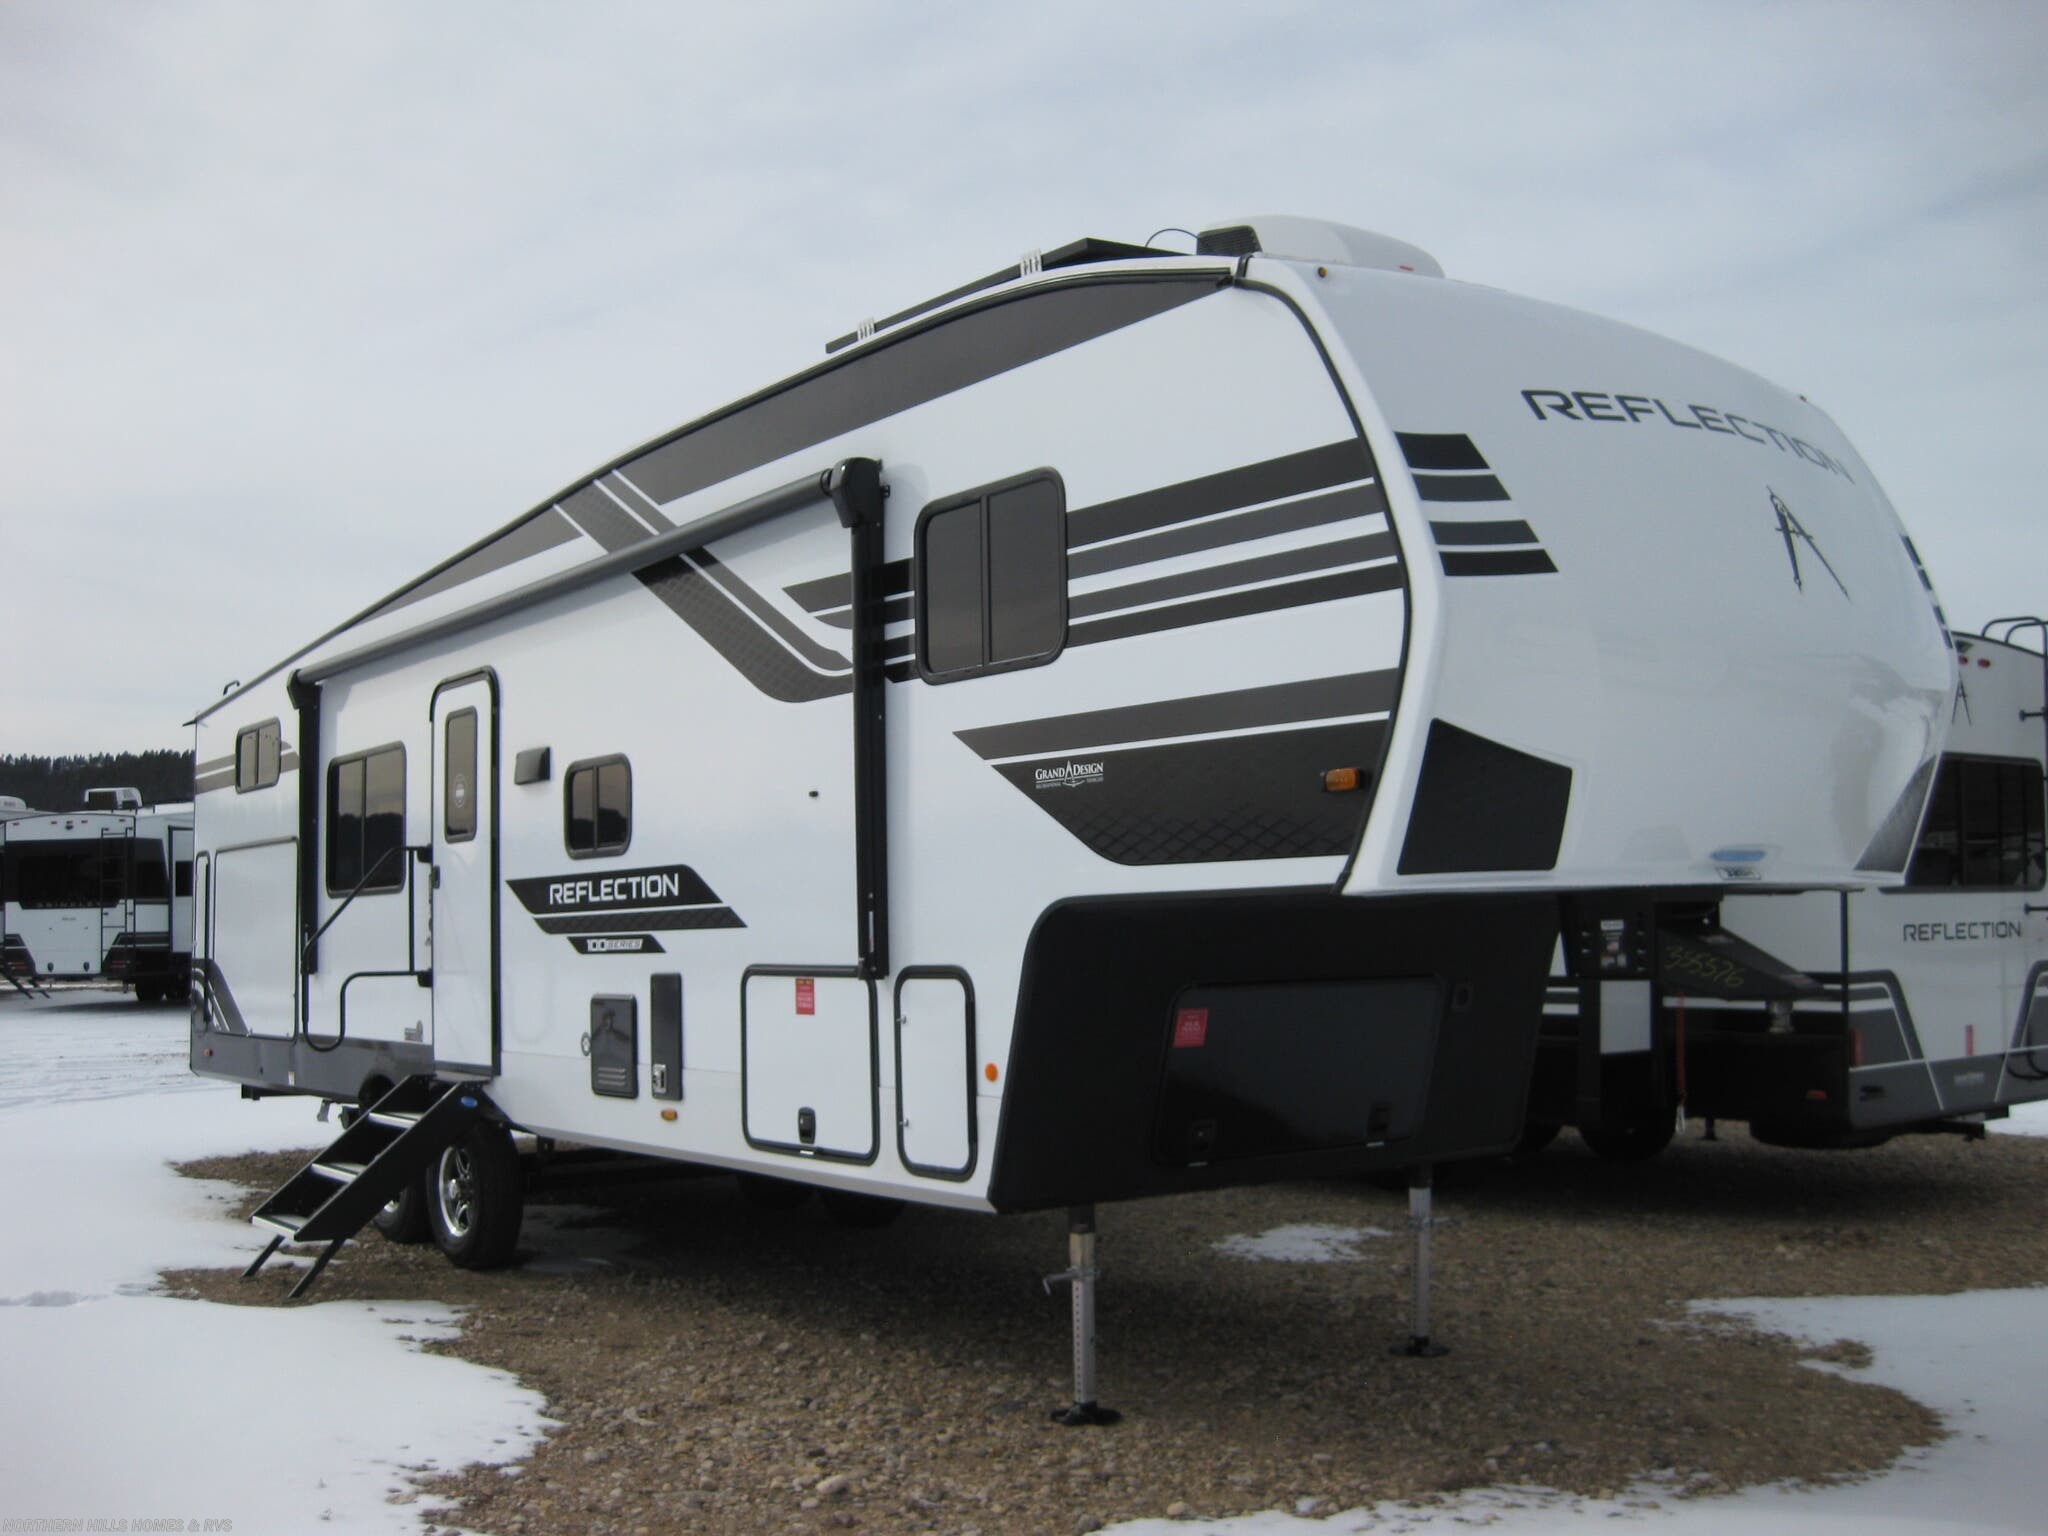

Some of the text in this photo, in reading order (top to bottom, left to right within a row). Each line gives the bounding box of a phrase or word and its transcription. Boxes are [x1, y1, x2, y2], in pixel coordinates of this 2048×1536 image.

[1520, 390, 1855, 485] REFLECTION
[549, 873, 680, 905] REFLECTION
[1903, 921, 2022, 942] REFLECTION
